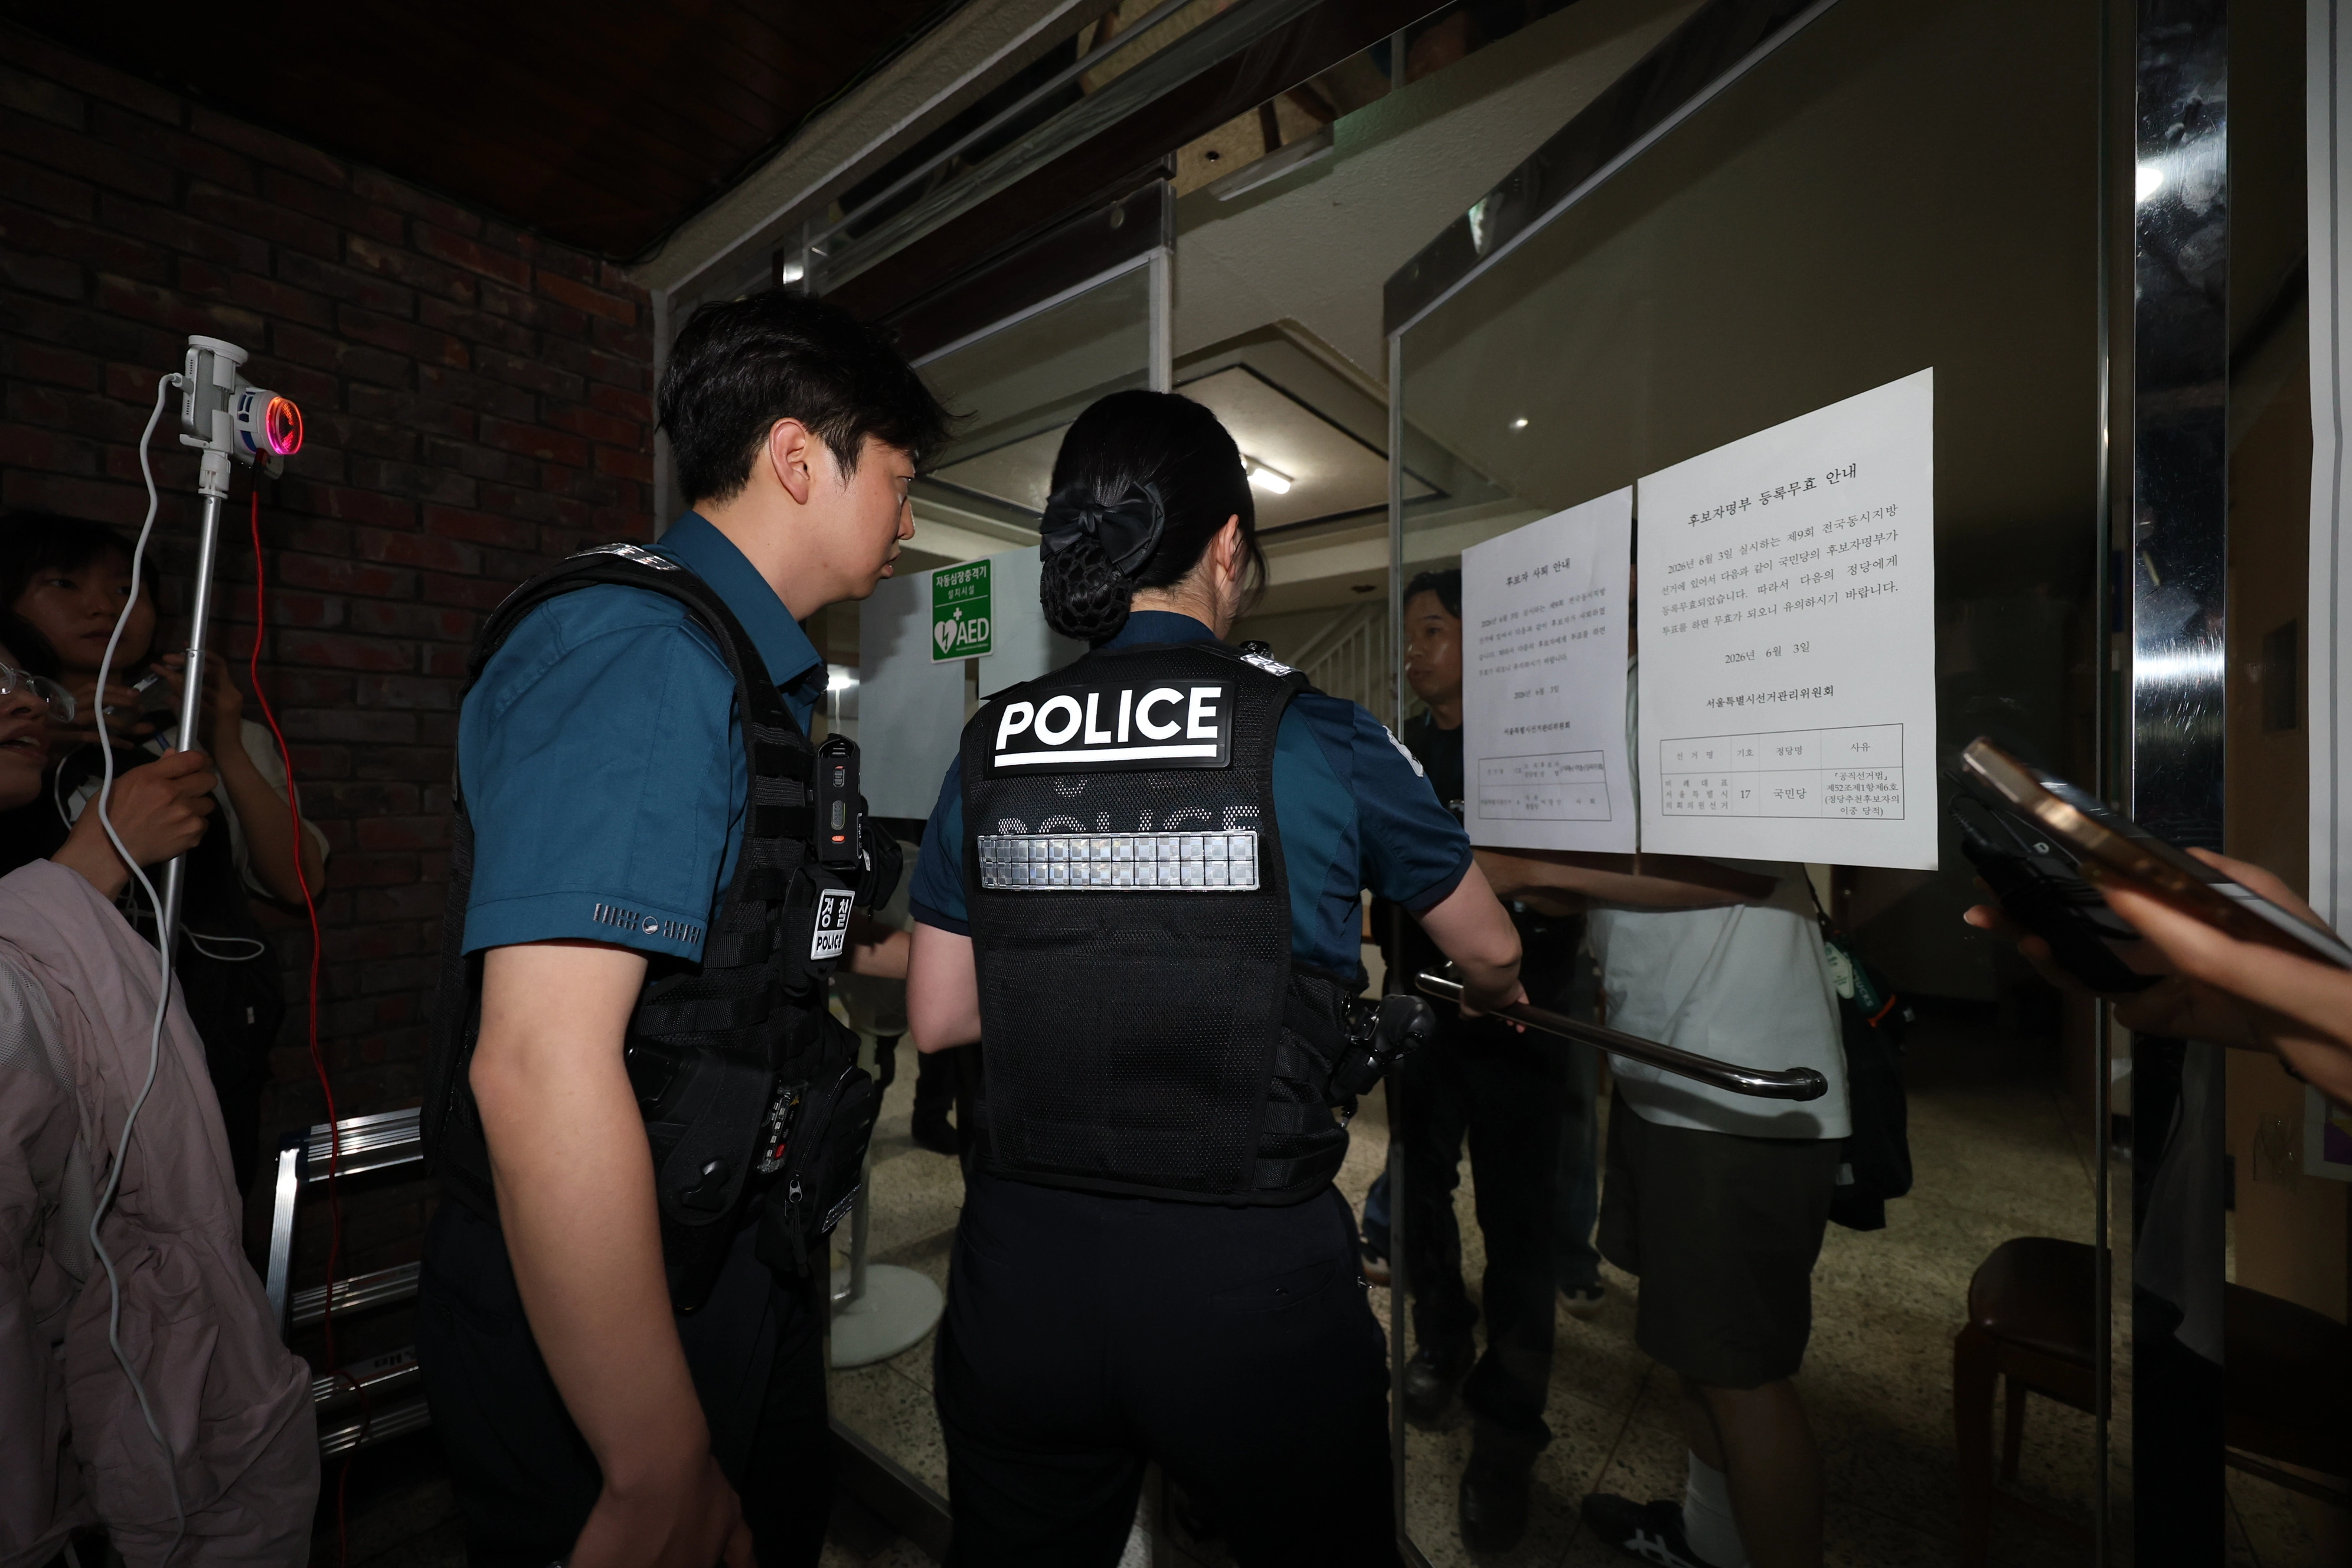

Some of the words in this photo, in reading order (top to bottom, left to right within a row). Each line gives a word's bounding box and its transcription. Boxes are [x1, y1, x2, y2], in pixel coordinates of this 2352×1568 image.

[1687, 497, 1752, 528] 후보자명부
[1759, 476, 1817, 505] 등록무효
[1825, 463, 1857, 485] 안내
[1667, 558, 1694, 574] 2026년
[1698, 553, 1713, 566] 6월
[1718, 548, 1733, 560] 3일
[1739, 537, 1781, 554] 실시하는
[1786, 526, 1815, 543] 제9회
[1822, 504, 1899, 533] 전국동시지방
[1553, 558, 1571, 573] 안내
[1661, 582, 1685, 595] 선거에
[1690, 574, 1716, 589] 있어서
[1721, 566, 1749, 580] 다음과
[1754, 560, 1773, 573] 같이
[1777, 547, 1820, 567] 국민당의
[1826, 529, 1899, 556] 후보자명부가
[936, 566, 986, 587] 자동심장충격기
[1661, 589, 1748, 616] 등록무효되었습니다.
[1757, 579, 1789, 594] 따라서
[1799, 569, 1835, 586] 다음의
[1847, 554, 1899, 576] 정당에게
[948, 585, 974, 600] 설치시설
[1662, 622, 1687, 636] 투표를
[1691, 618, 1709, 629] 하면
[1714, 611, 1743, 626] 무효가
[1747, 604, 1778, 620] 되오니
[1783, 592, 1839, 613] 유의하시기
[1845, 582, 1899, 601] 바랍니다.
[956, 618, 989, 645] AED
[1724, 651, 1756, 665] 2026년
[1765, 645, 1782, 659] 6월
[1792, 641, 1810, 654] 3일
[1706, 685, 1834, 709] 서울특별시선거관리위원회
[995, 687, 1221, 750] POLICE
[1736, 748, 1754, 758] 기호
[1775, 746, 1803, 757] 정당명
[1850, 742, 1871, 753] 사유
[1739, 789, 1752, 799] 17
[1772, 788, 1808, 800] 국민당
[1827, 783, 1898, 792] 제52조제1항제6호
[1825, 795, 1899, 804] (정당추천후보자의
[1840, 806, 1858, 815] 이중
[1863, 806, 1883, 817] 당적)
[822, 897, 849, 928] 경찰
[816, 935, 842, 950] POLICE
